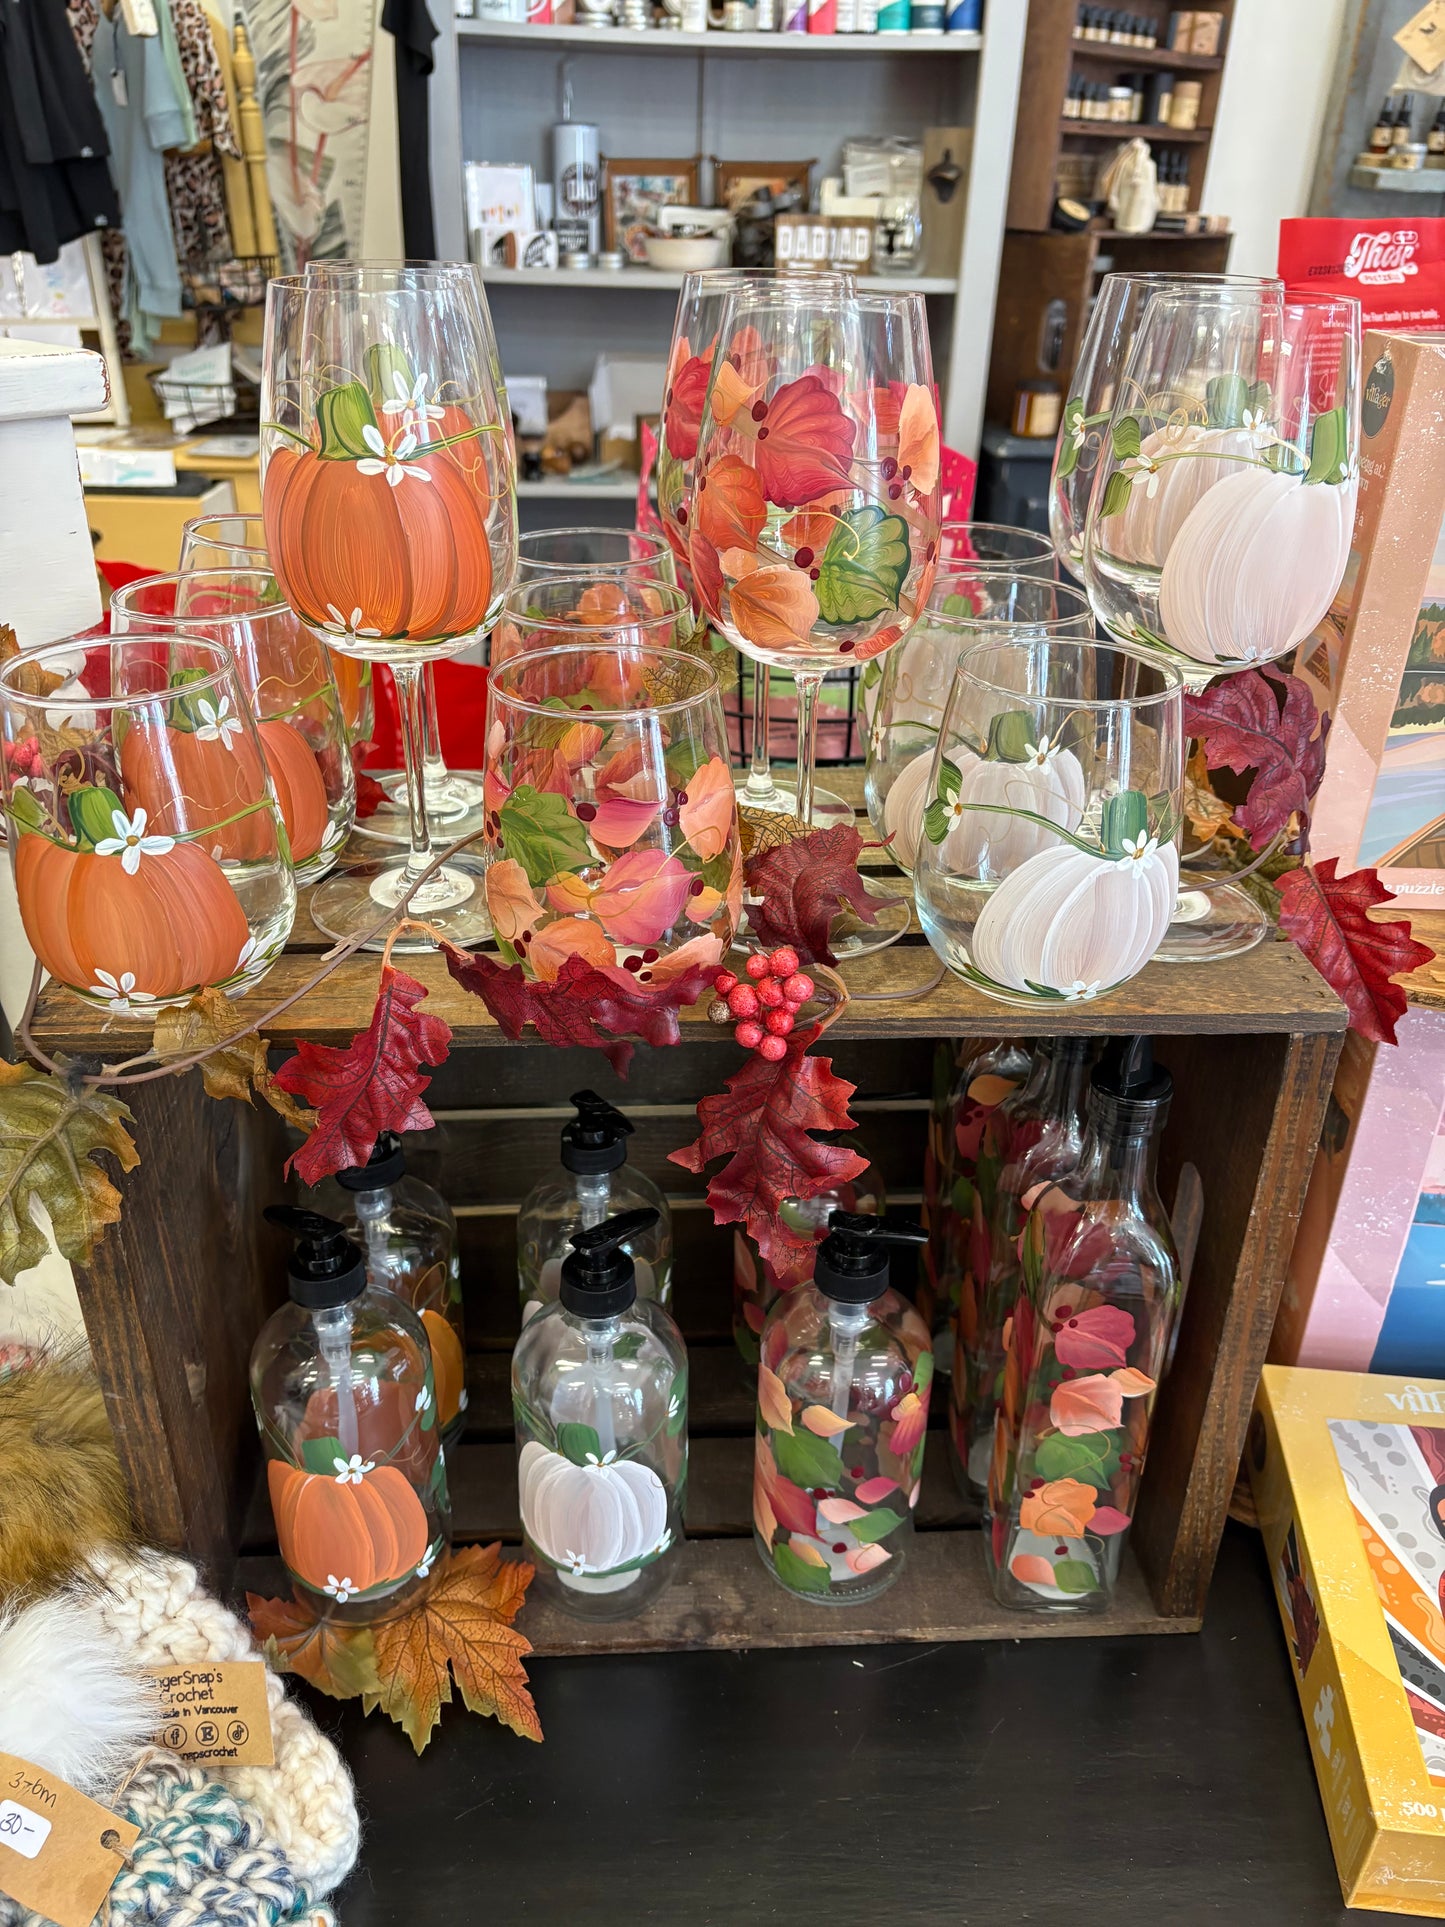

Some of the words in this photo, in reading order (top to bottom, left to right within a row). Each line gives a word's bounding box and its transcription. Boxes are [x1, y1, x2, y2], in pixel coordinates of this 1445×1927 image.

[776, 225, 827, 260] DAD
[1343, 231, 1419, 278] Those
[1384, 310, 1402, 322] family
[1395, 882, 1445, 896] puzzle
[193, 1704, 239, 1716] Vancouver
[1401, 1801, 1438, 1818] 500
